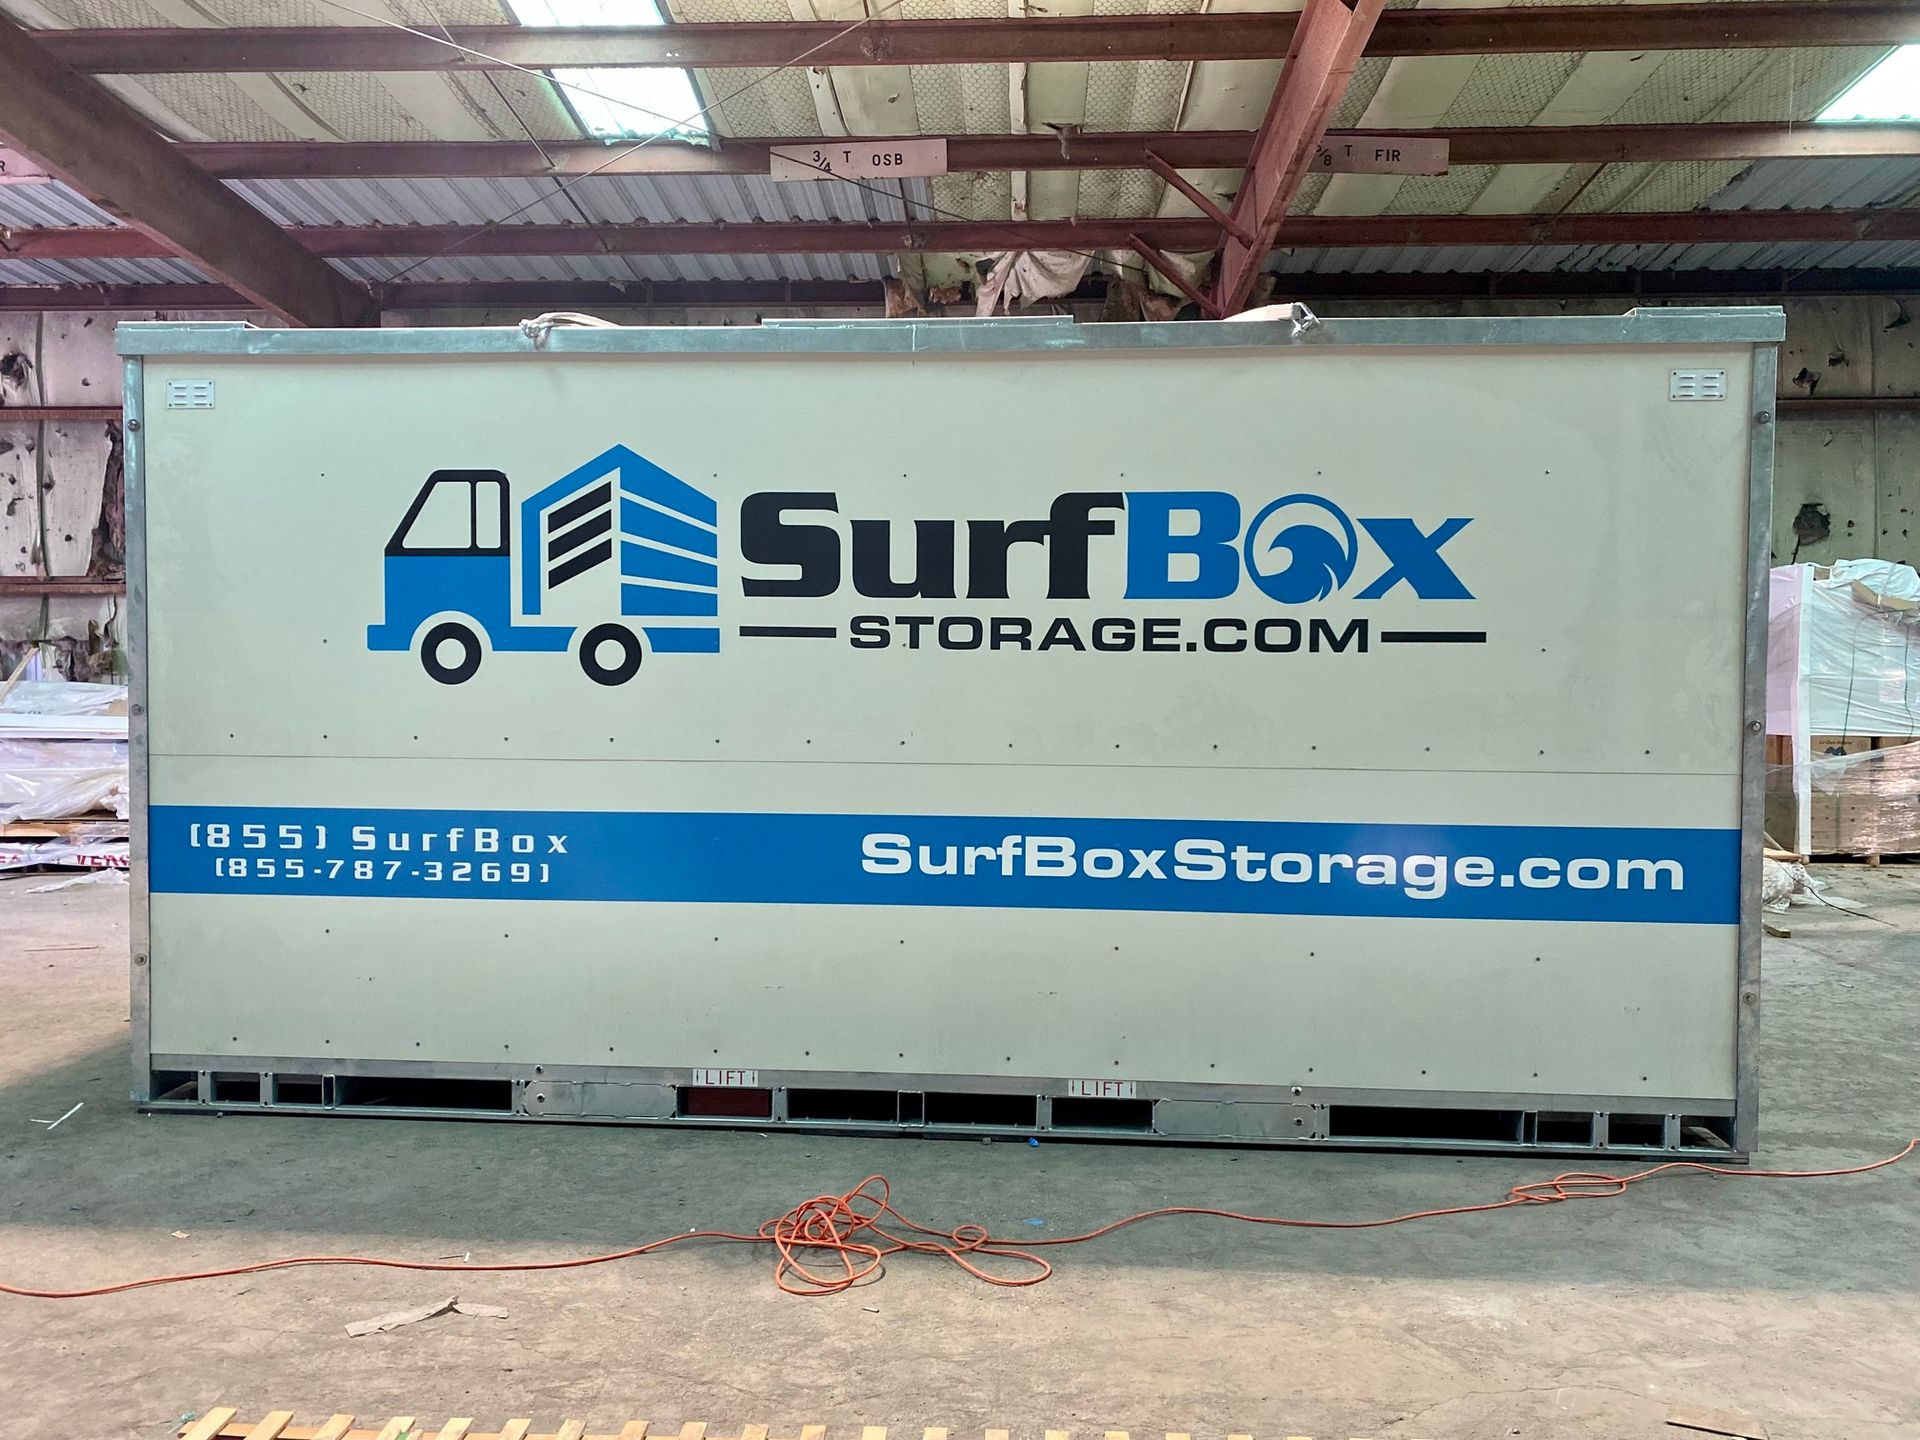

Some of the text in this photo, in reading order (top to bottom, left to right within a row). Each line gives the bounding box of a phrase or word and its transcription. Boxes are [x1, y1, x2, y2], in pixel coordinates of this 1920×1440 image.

[812, 150, 904, 172] 3/4 T OSB
[1344, 144, 1353, 157] T
[1375, 149, 1401, 162] FIR
[740, 491, 1477, 605] SurfBox
[850, 615, 1369, 653] STORAGE.COM
[352, 825, 568, 854] SurfBox
[861, 833, 1684, 900] SurfBoxStorage.com
[705, 1070, 746, 1085] LIFT
[1081, 1080, 1124, 1097] LIFT
